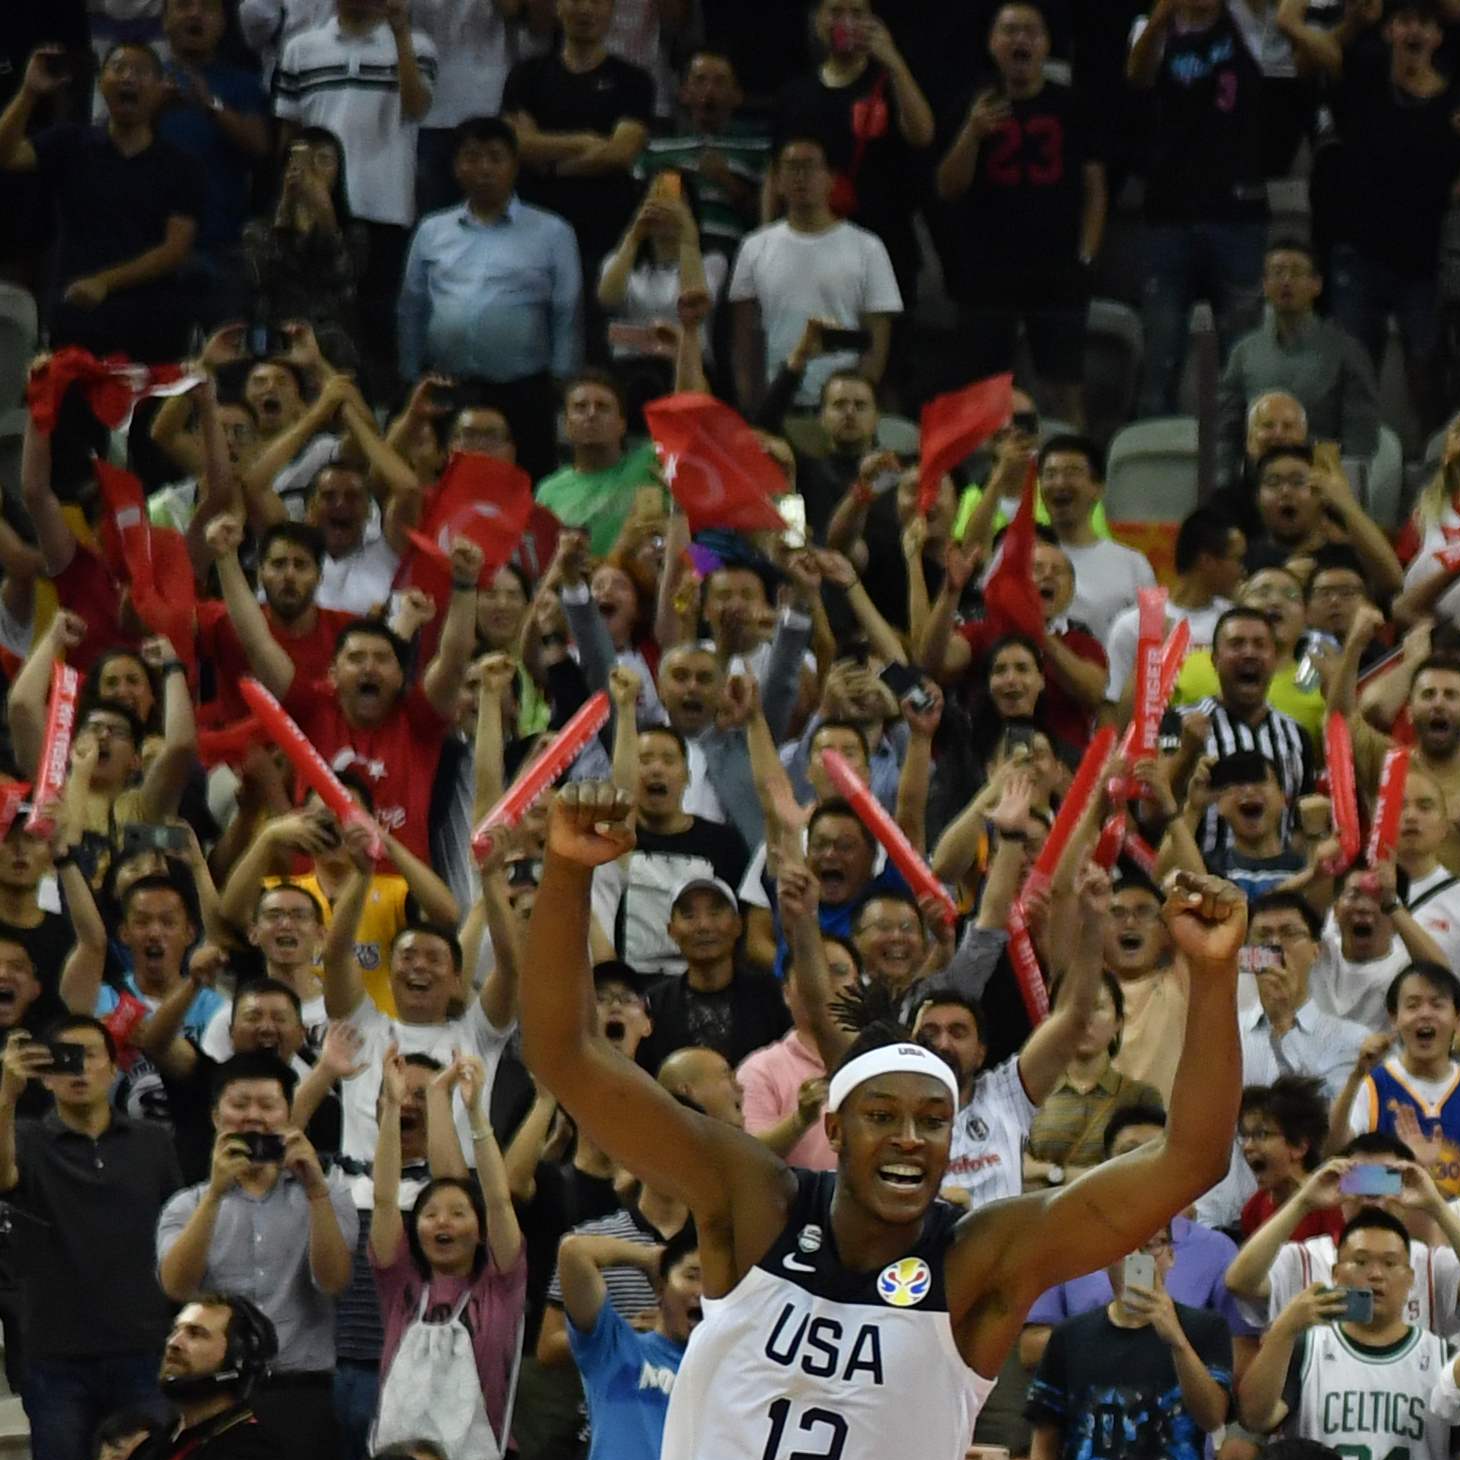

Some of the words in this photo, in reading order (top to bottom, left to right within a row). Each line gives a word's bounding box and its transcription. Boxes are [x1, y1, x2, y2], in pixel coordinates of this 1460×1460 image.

[896, 1047, 927, 1058] USA
[764, 1302, 884, 1386] USA
[1323, 1391, 1426, 1441] CELTICS
